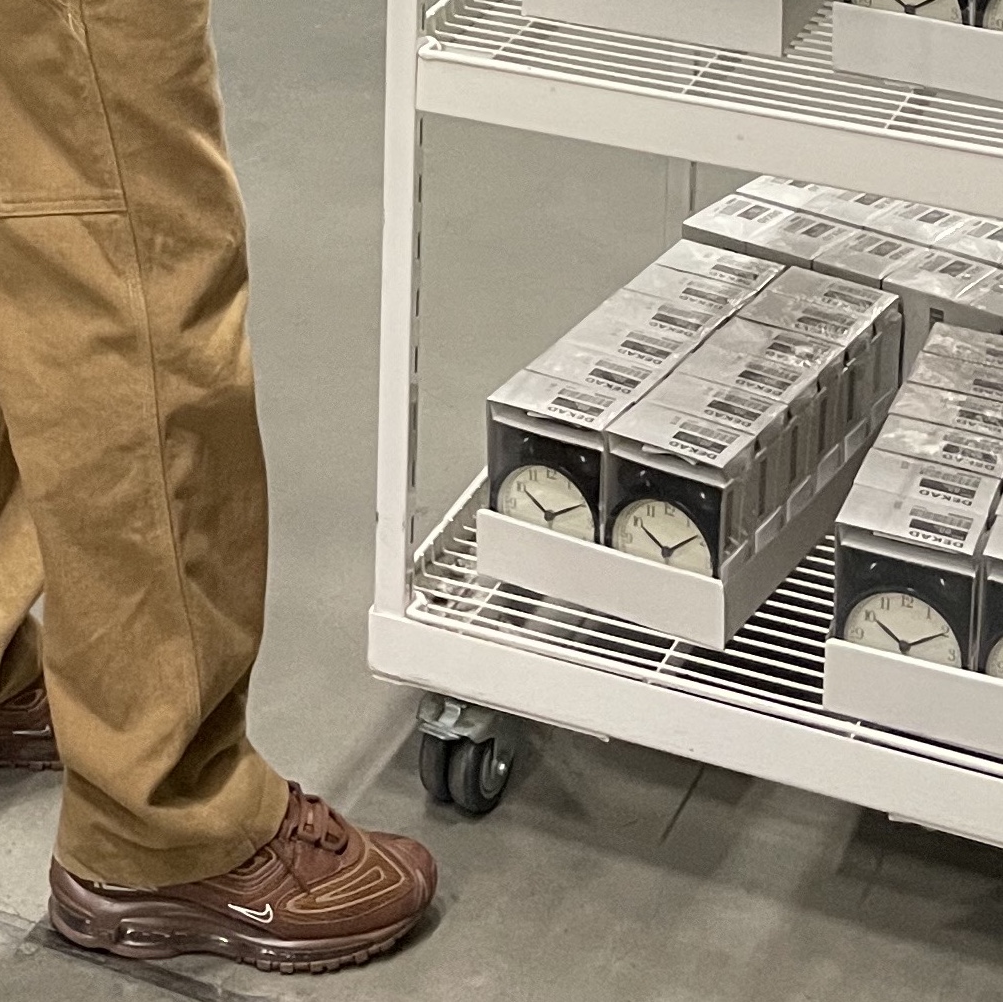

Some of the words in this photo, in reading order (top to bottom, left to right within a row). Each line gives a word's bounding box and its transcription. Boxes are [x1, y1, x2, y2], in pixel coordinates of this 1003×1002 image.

[648, 321, 694, 337] DEKAD
[617, 348, 663, 365] DEKAD
[584, 377, 632, 395] DEKAD
[735, 379, 782, 397] DEKAD
[547, 406, 595, 423] DEKAD
[703, 409, 752, 428] DEKAD
[668, 440, 717, 460] DEKAD
[528, 469, 538, 482] 11
[546, 467, 558, 480] 12
[516, 481, 527, 492] 10
[918, 489, 973, 507] DEKAD
[646, 504, 656, 517] 11
[664, 504, 676, 517] 12
[633, 515, 644, 528] 10
[908, 530, 964, 549] DEKAD
[880, 596, 890, 611] 11
[900, 594, 915, 608] 12
[864, 610, 876, 622] 10
[925, 606, 931, 620] 1
[857, 628, 865, 639] 9
